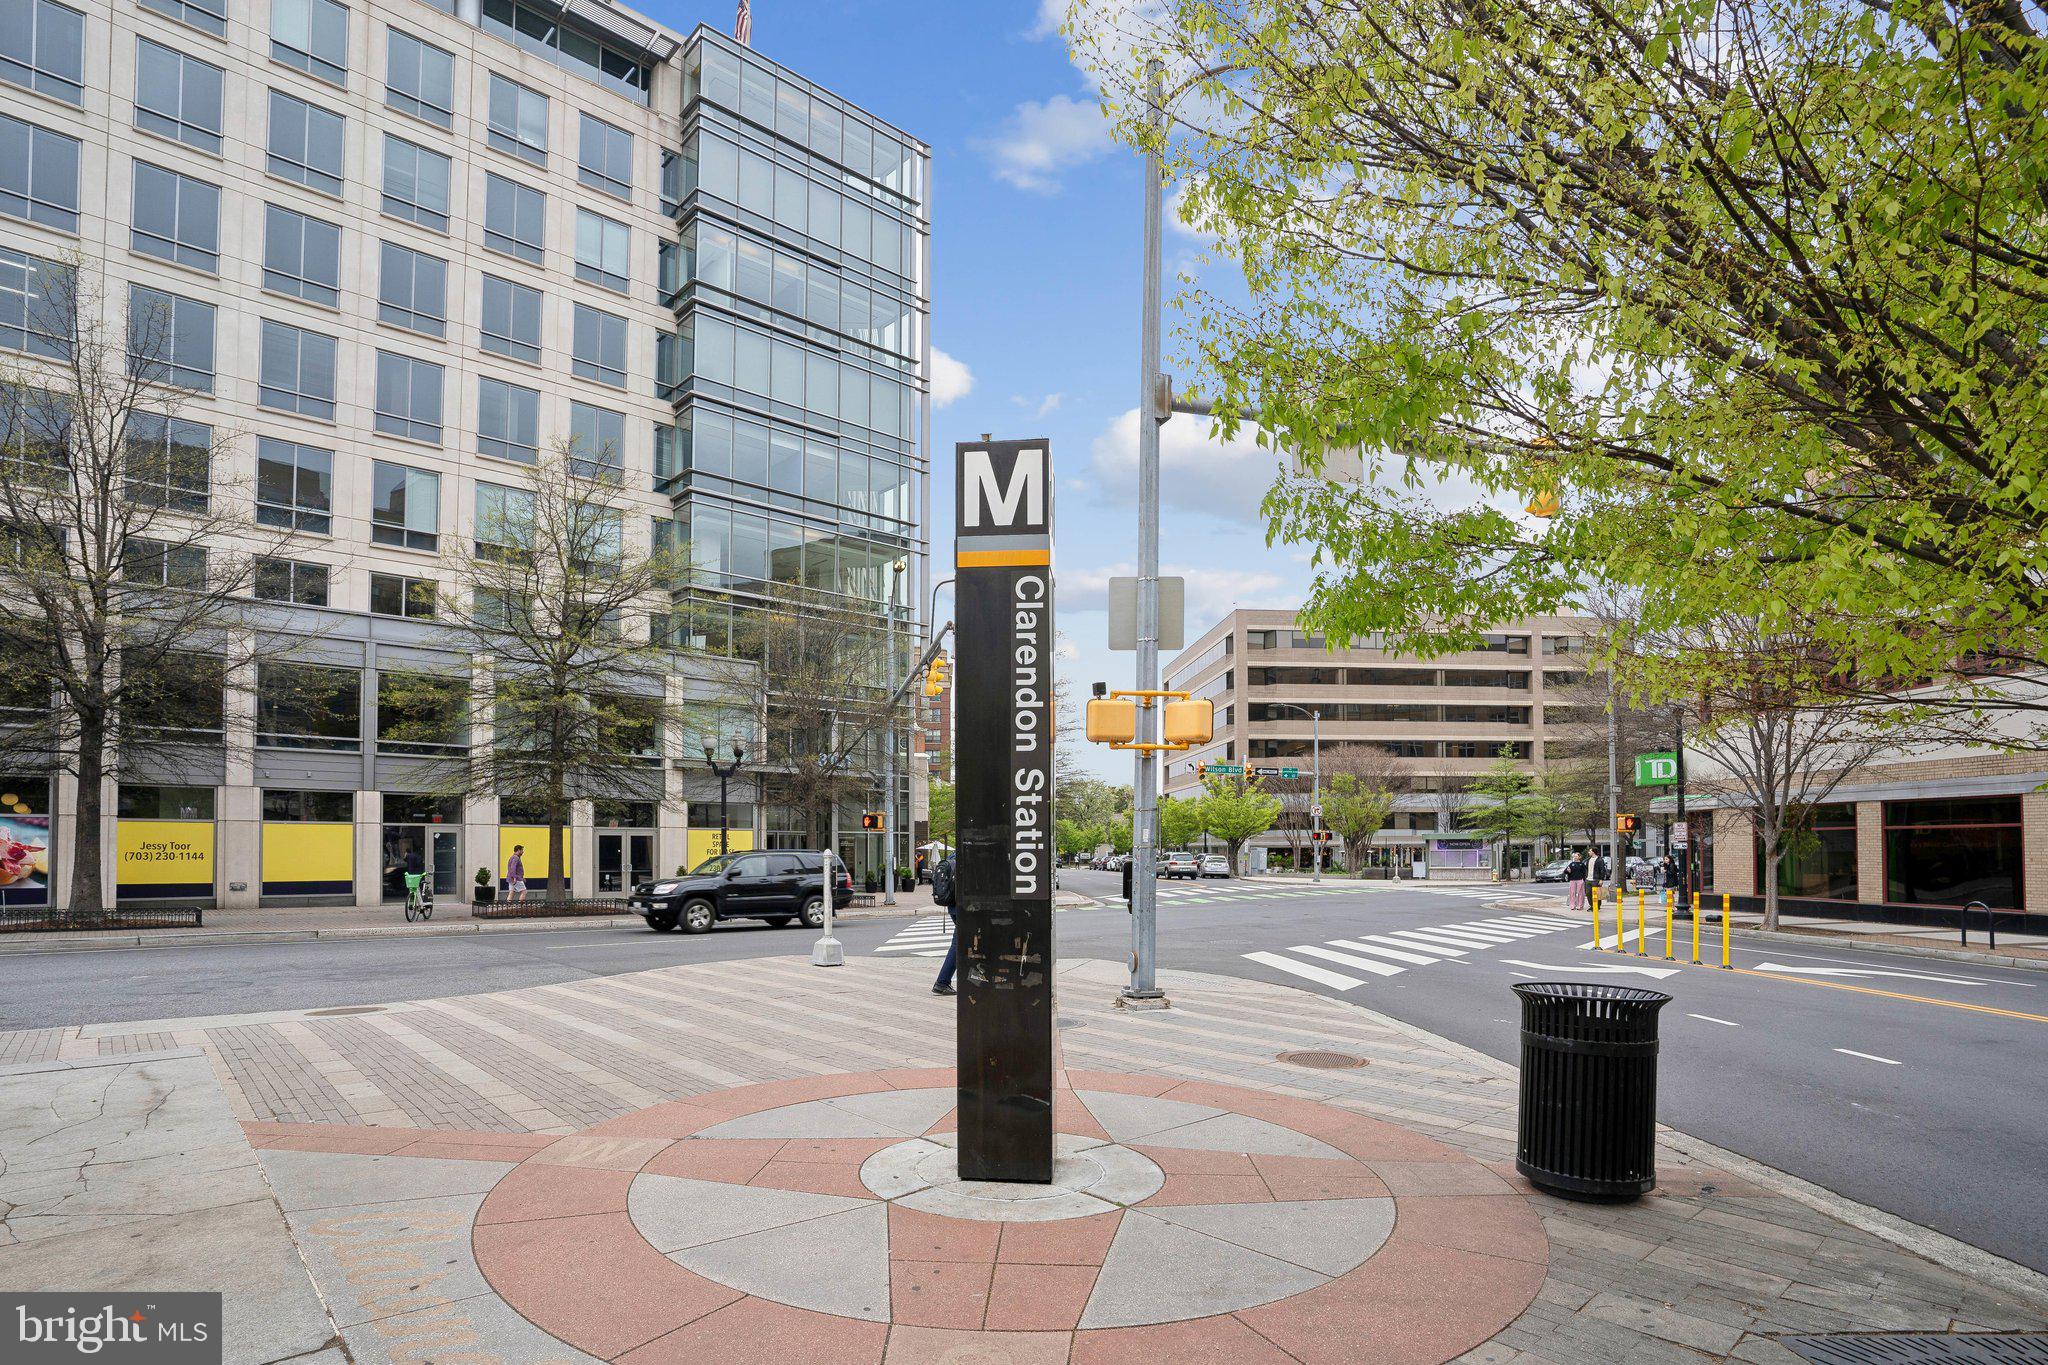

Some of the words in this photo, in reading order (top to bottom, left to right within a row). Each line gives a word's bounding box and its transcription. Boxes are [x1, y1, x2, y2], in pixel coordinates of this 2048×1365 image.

[964, 449, 1043, 527] M
[1015, 575, 1045, 752] Clarendon
[1205, 765, 1227, 773] Wilson
[1229, 765, 1242, 774] Blvd
[1644, 758, 1677, 779] TD
[1015, 768, 1045, 894] Station
[124, 852, 153, 862] (703)
[155, 852, 204, 861] 230-1144
[140, 842, 167, 852] Jessy
[170, 841, 191, 851] Toor
